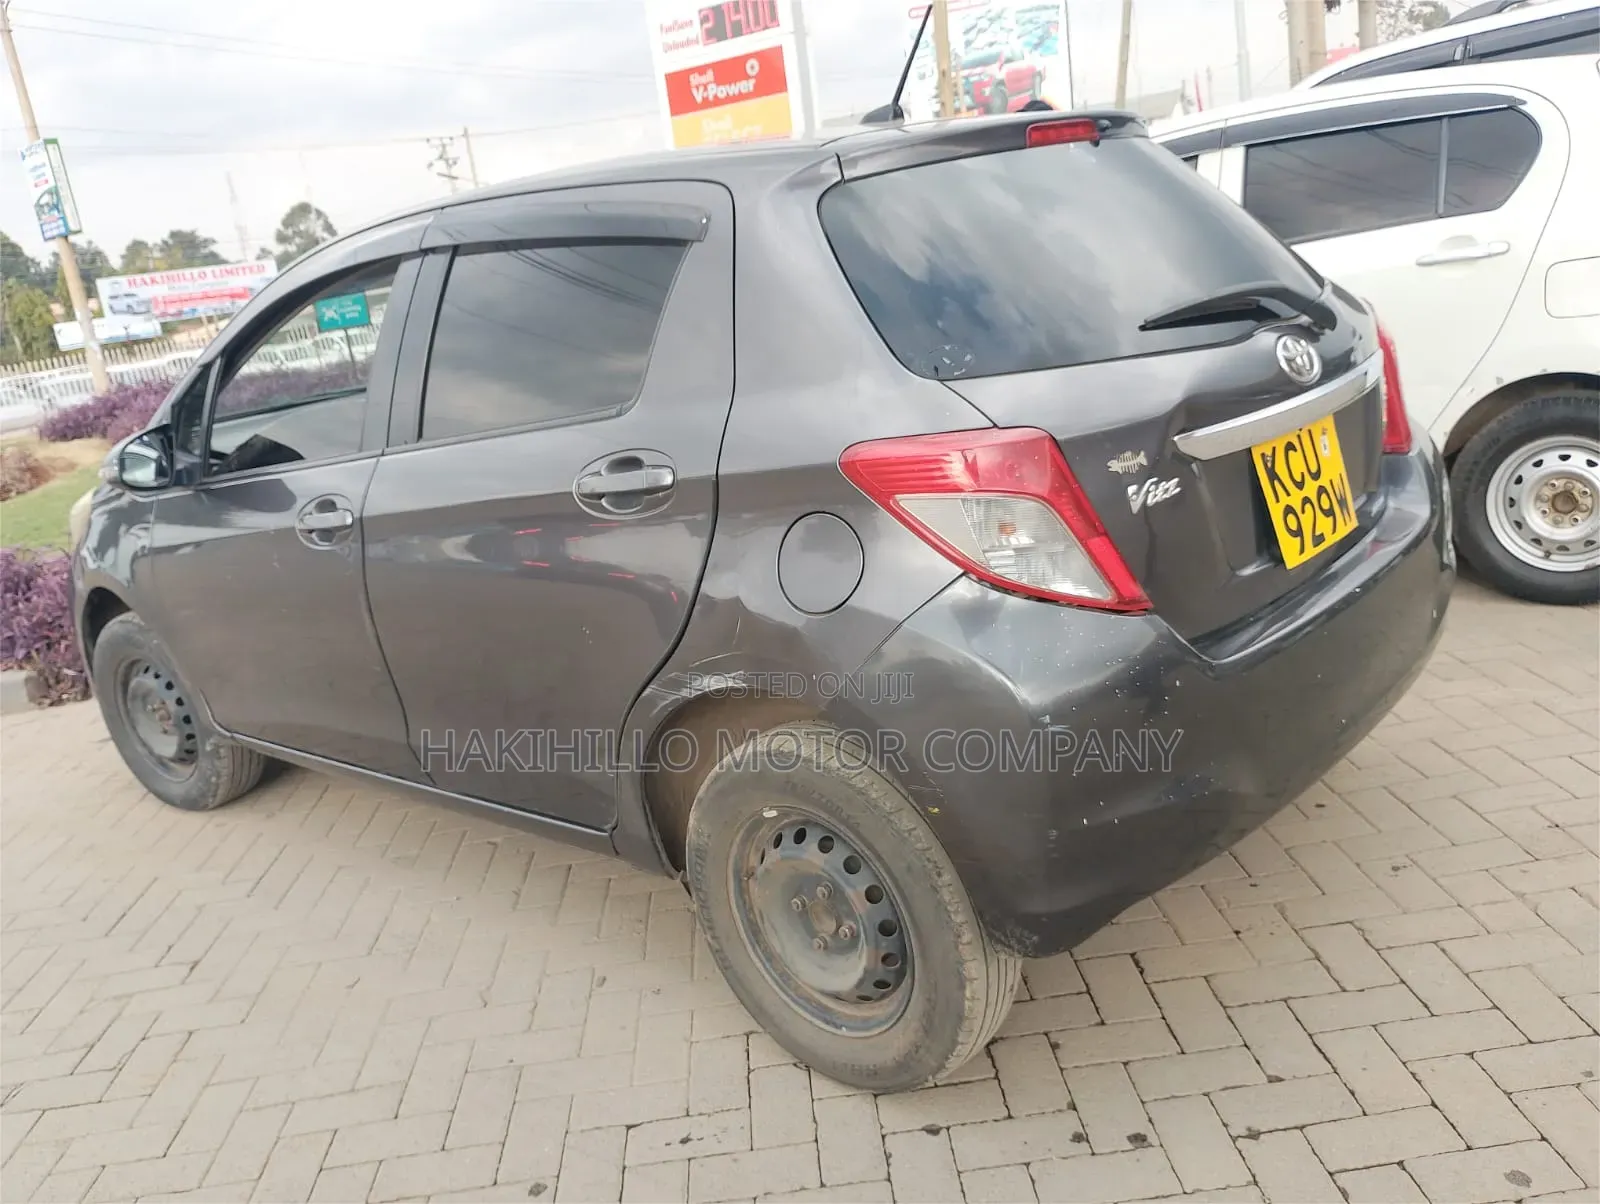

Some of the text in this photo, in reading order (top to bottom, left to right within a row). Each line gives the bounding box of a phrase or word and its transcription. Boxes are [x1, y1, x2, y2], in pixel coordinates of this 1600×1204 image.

[689, 69, 714, 86] Shell
[692, 77, 756, 104] V-Power
[211, 263, 266, 279] LIMITED
[1262, 427, 1322, 504] KCU
[1282, 472, 1352, 557] 929W
